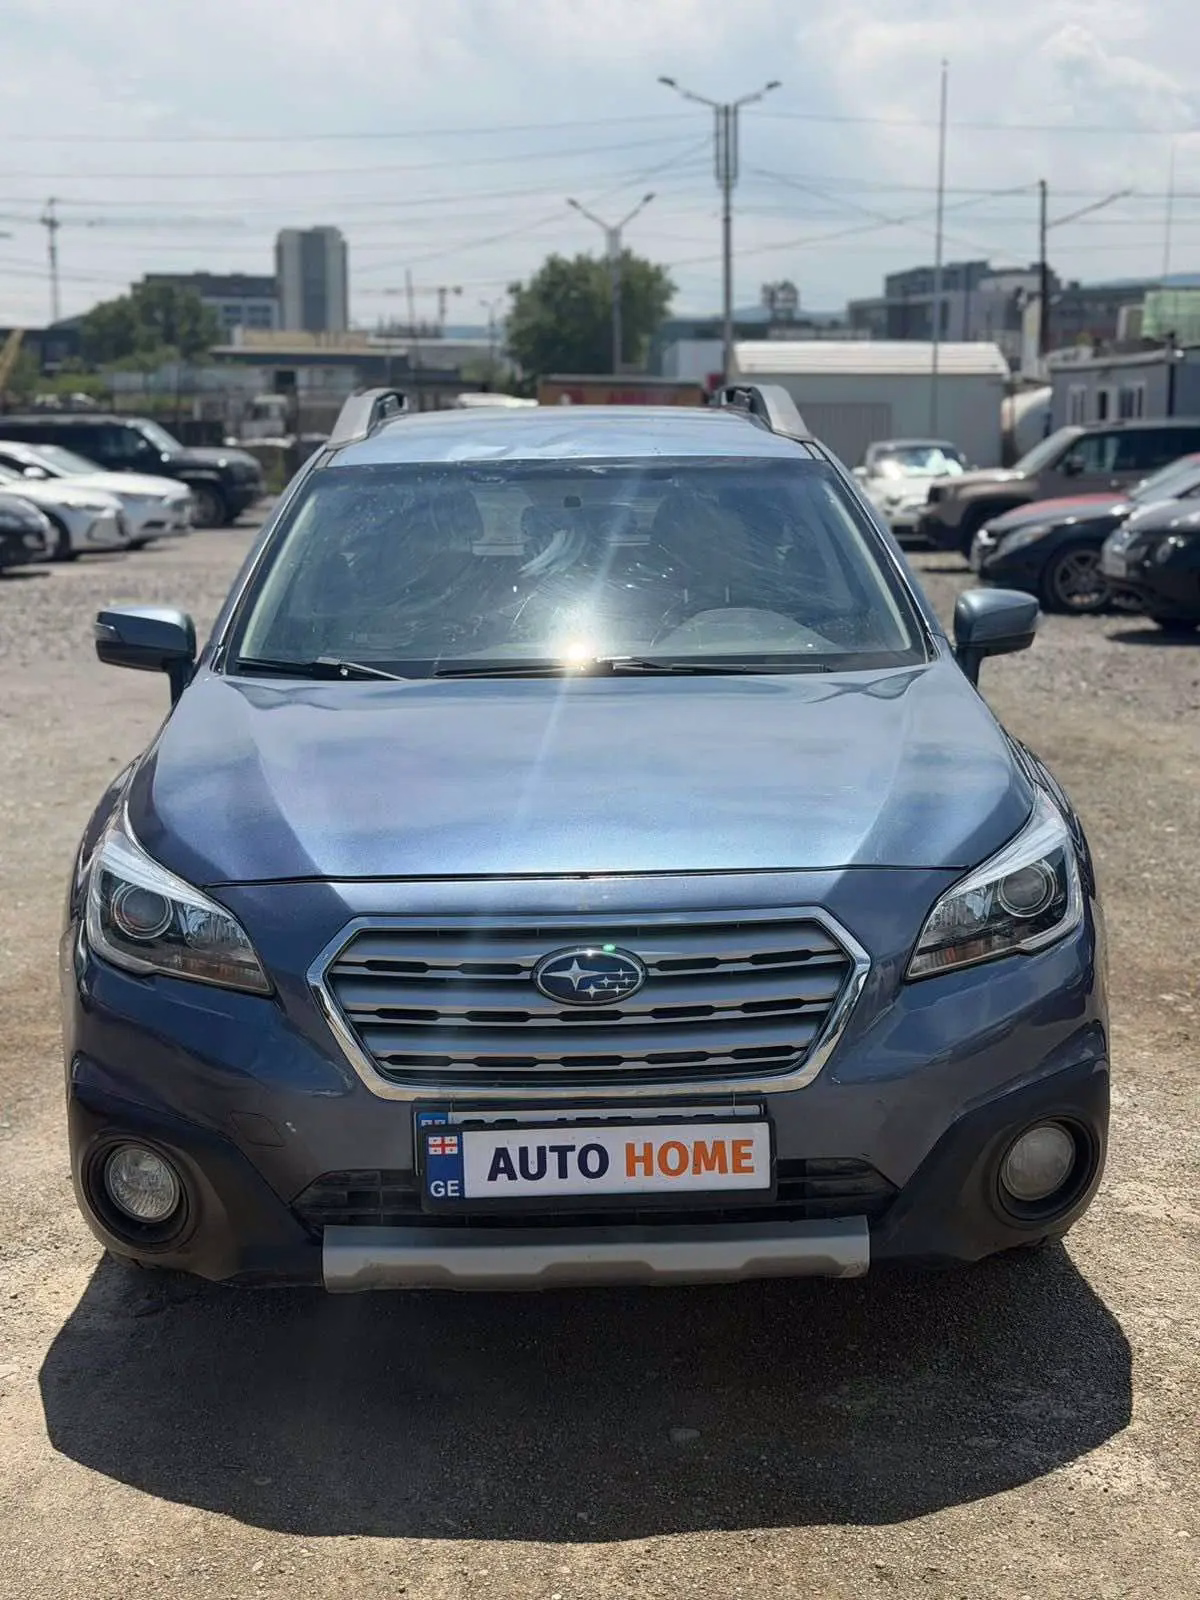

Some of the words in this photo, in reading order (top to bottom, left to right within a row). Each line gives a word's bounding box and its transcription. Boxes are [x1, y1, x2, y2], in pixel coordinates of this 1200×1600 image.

[487, 1144, 609, 1181] AUTO
[625, 1139, 755, 1178] HOME
[430, 1180, 460, 1197] GE
